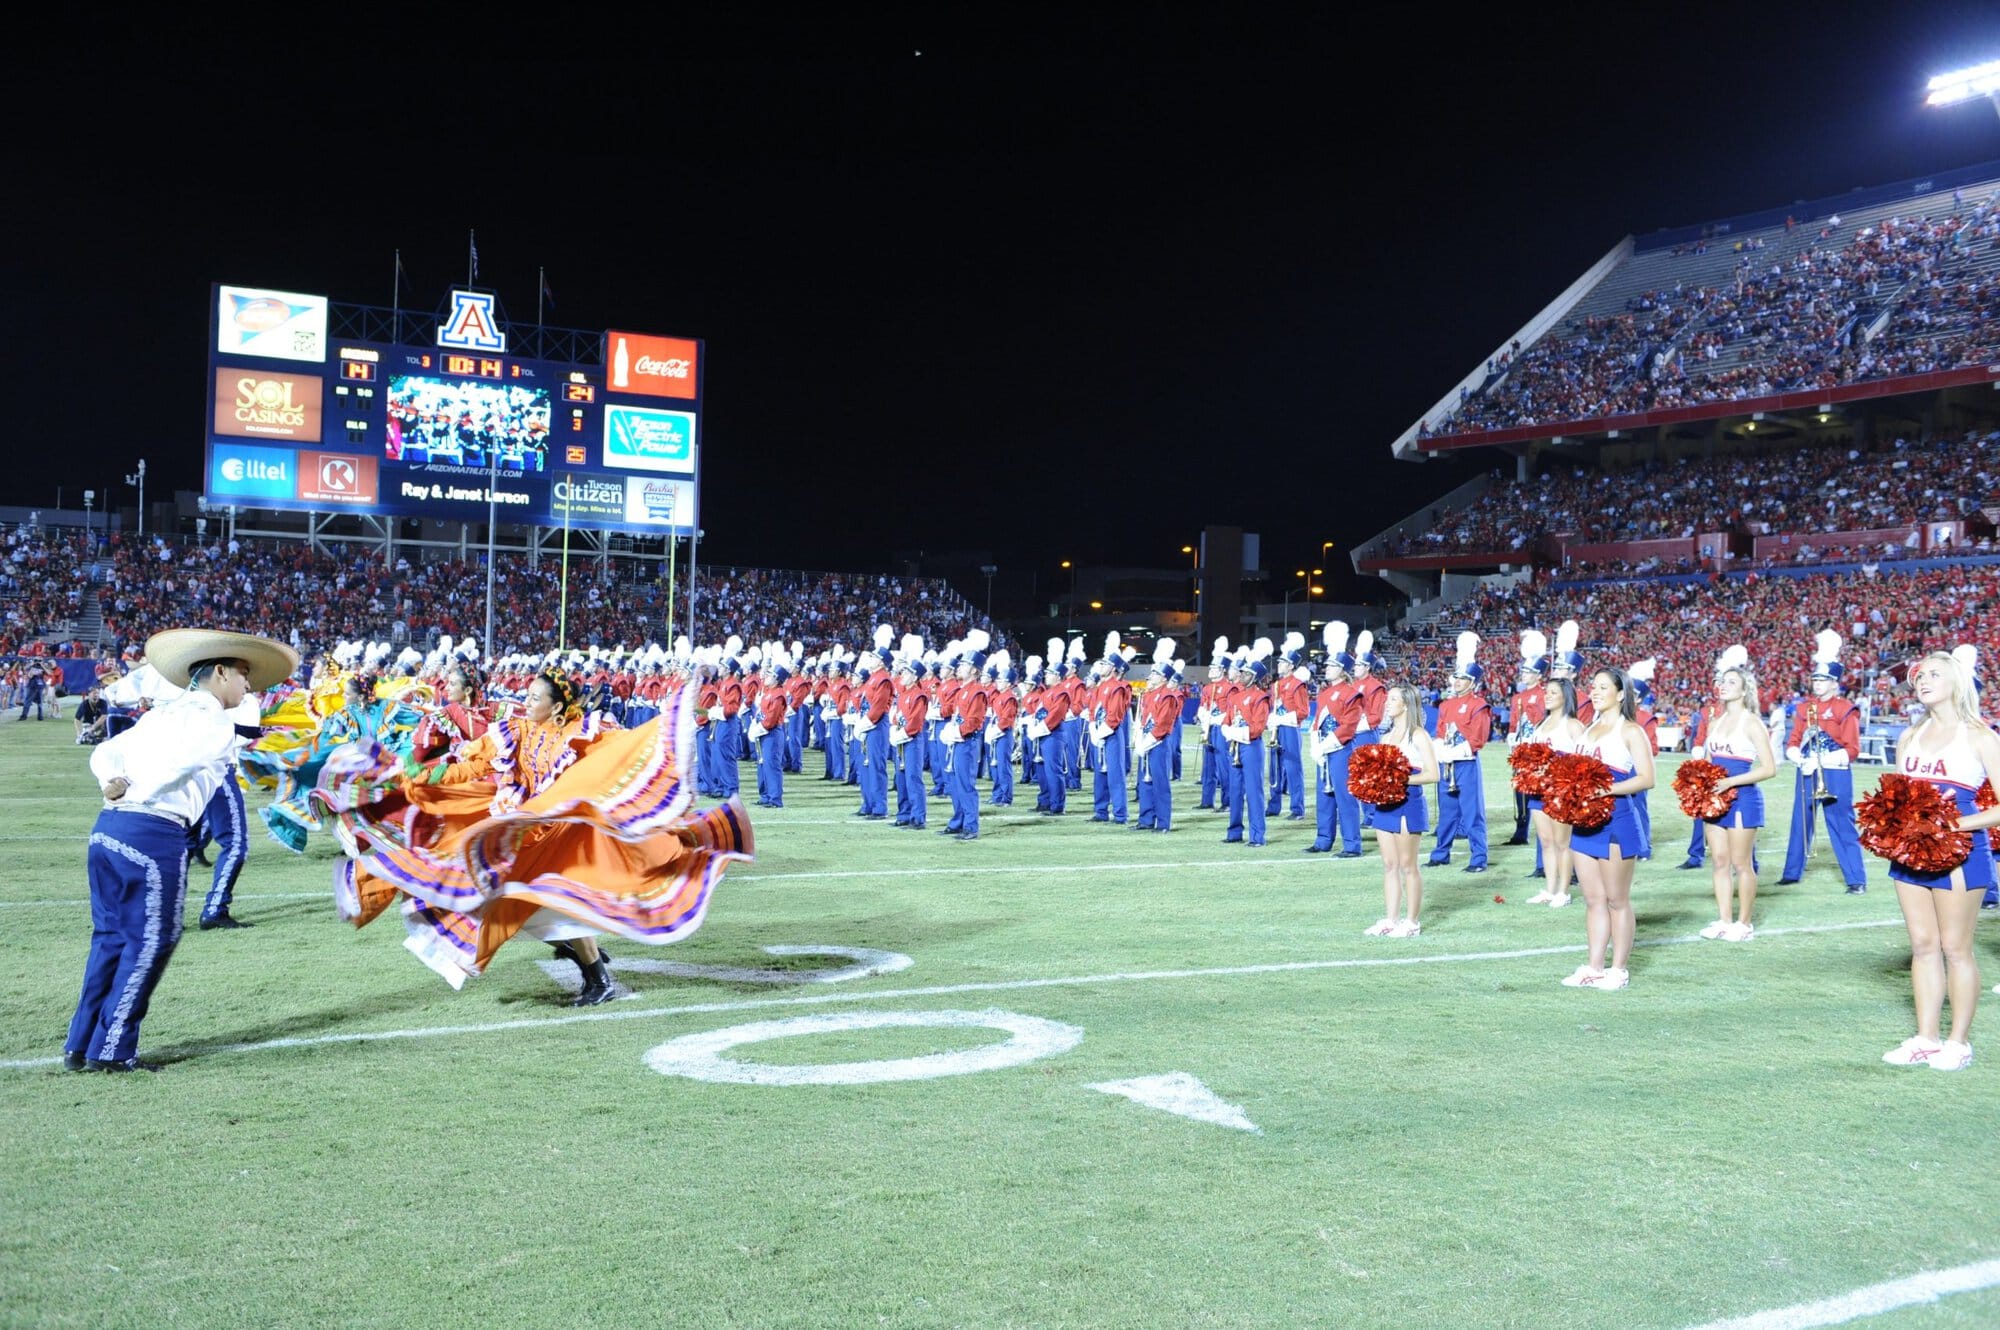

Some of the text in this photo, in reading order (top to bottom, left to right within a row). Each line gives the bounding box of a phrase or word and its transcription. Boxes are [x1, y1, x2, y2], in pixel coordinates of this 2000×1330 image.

[438, 290, 506, 353] A
[421, 355, 431, 368] 3
[634, 355, 691, 379] Coca-Cola
[511, 365, 520, 378] 3
[236, 378, 304, 412] SOL
[235, 408, 304, 427] CASINOS
[567, 447, 585, 462] 25
[326, 461, 354, 490] K
[402, 482, 429, 500] Ray
[431, 485, 443, 499] &
[445, 486, 483, 501] Janet
[554, 482, 623, 504] Citizen
[588, 480, 622, 491] Tucson
[1905, 757, 1919, 773] U
[1933, 760, 1947, 776] A
